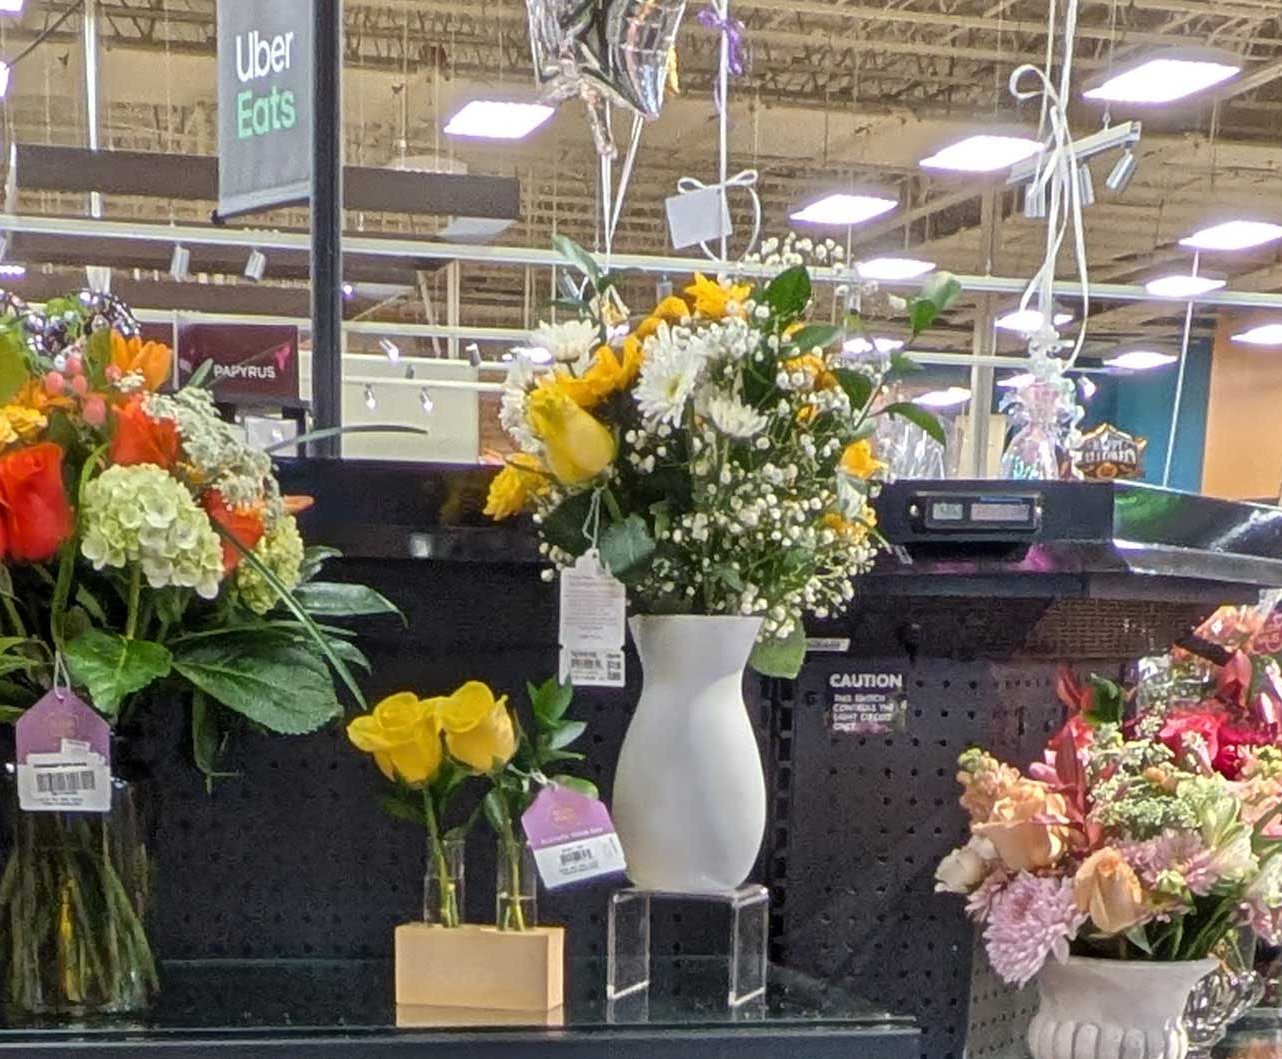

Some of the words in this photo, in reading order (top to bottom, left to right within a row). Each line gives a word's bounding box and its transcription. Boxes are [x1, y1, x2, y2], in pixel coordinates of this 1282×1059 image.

[235, 30, 294, 82] Uber
[237, 85, 296, 139] Eats
[213, 363, 276, 379] PAPYRUS
[829, 674, 903, 688] CAUTION
